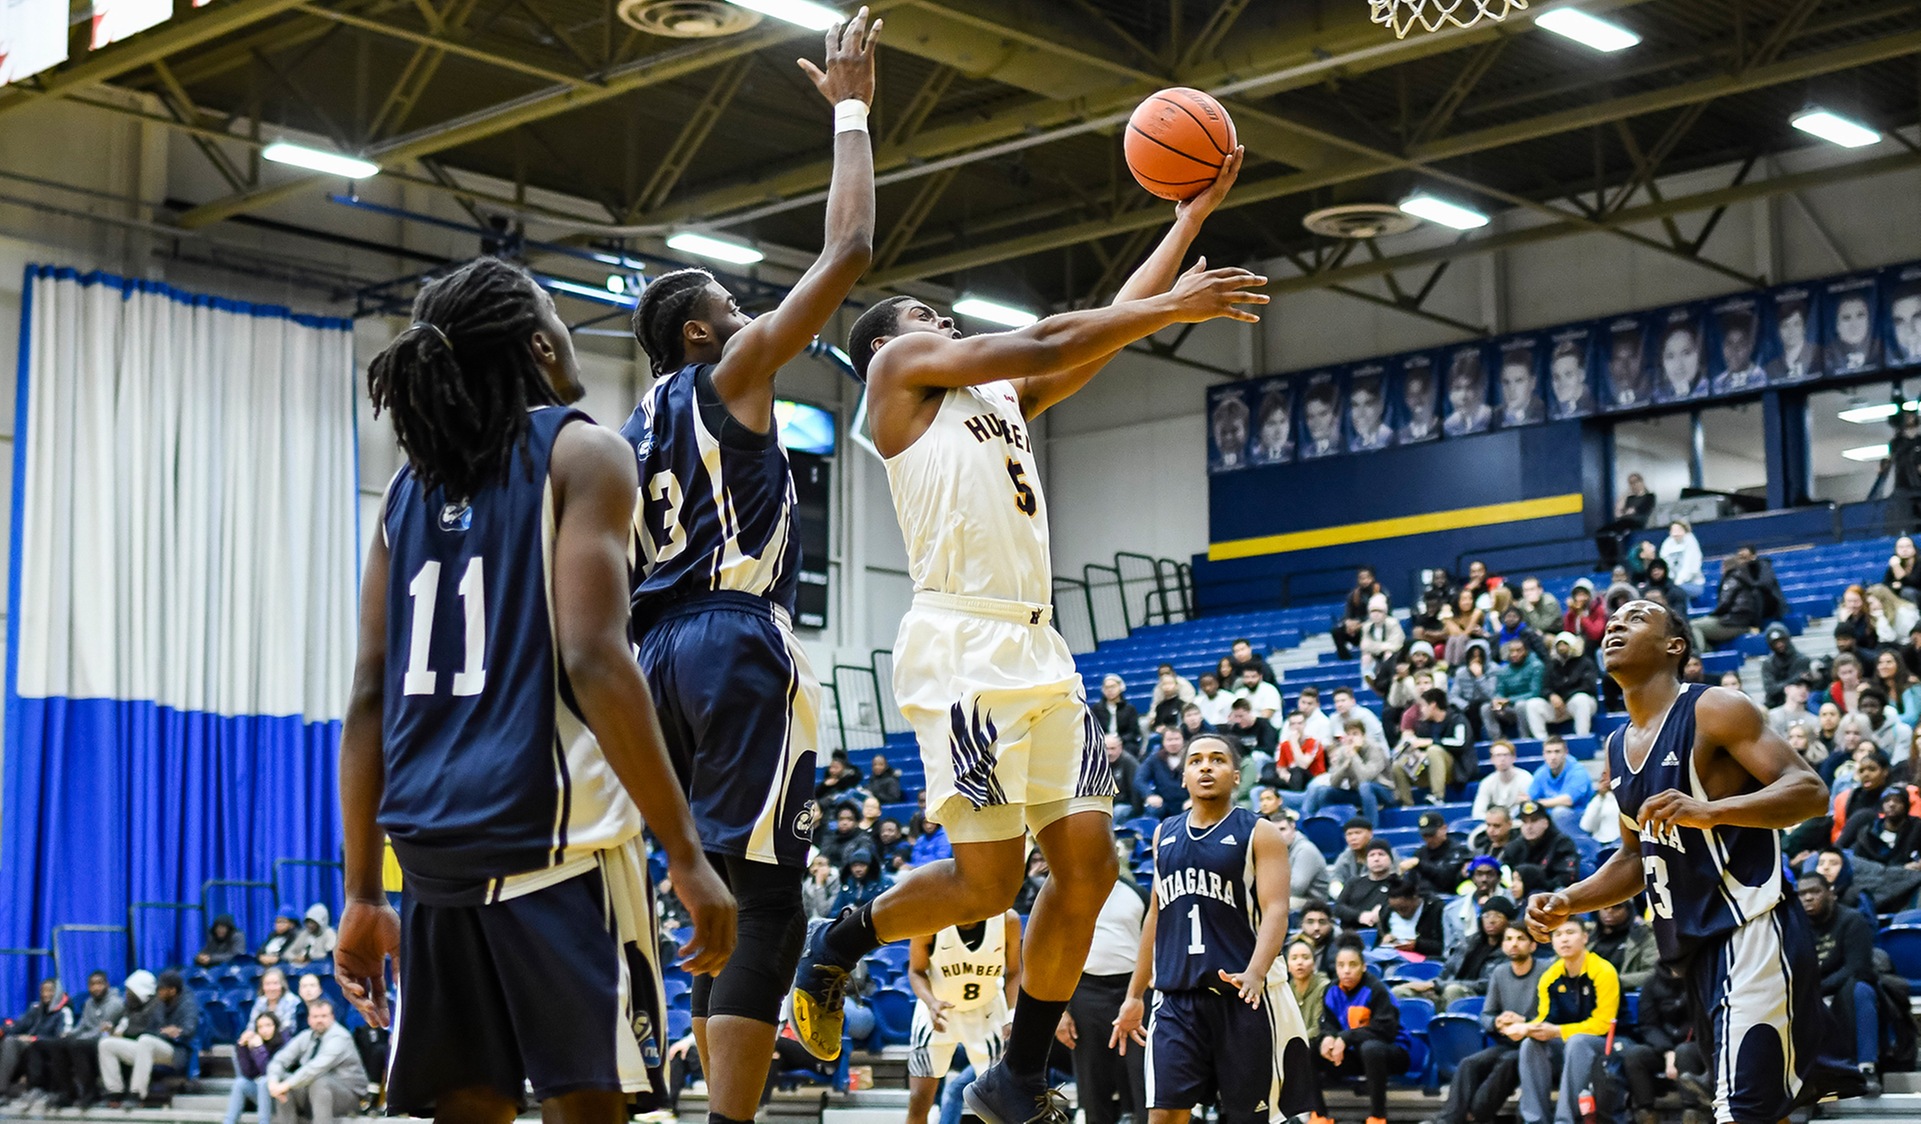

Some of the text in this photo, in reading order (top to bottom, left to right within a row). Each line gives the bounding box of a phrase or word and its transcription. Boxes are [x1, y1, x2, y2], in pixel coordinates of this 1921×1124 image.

[1005, 456, 1038, 519] 5
[404, 557, 486, 696] 11
[1159, 867, 1238, 910] NIAGARA
[1642, 855, 1674, 922] 3
[1187, 904, 1206, 955] 1
[941, 962, 1002, 978] HUMBER
[963, 983, 980, 1001] 8
